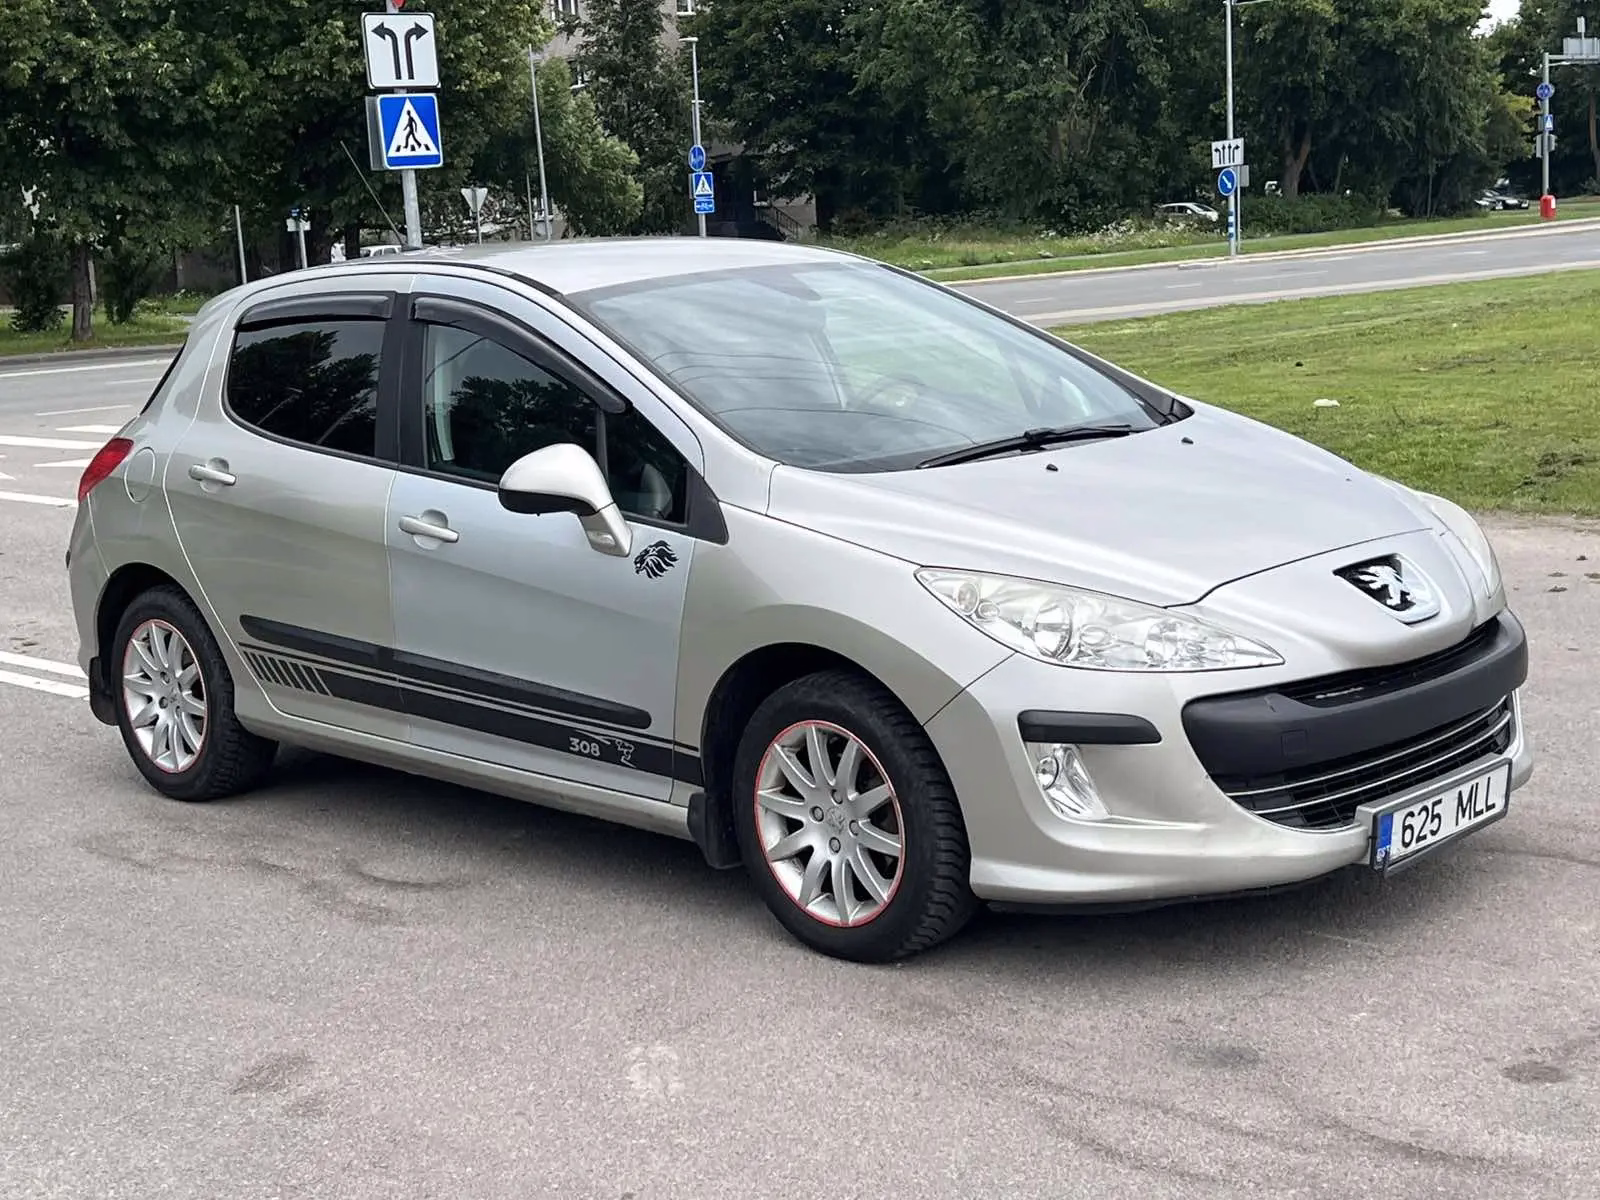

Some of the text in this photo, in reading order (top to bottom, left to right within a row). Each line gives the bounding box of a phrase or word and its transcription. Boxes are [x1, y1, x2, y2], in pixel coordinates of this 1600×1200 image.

[569, 736, 600, 757] 308
[1401, 776, 1496, 848] 625 MLL
